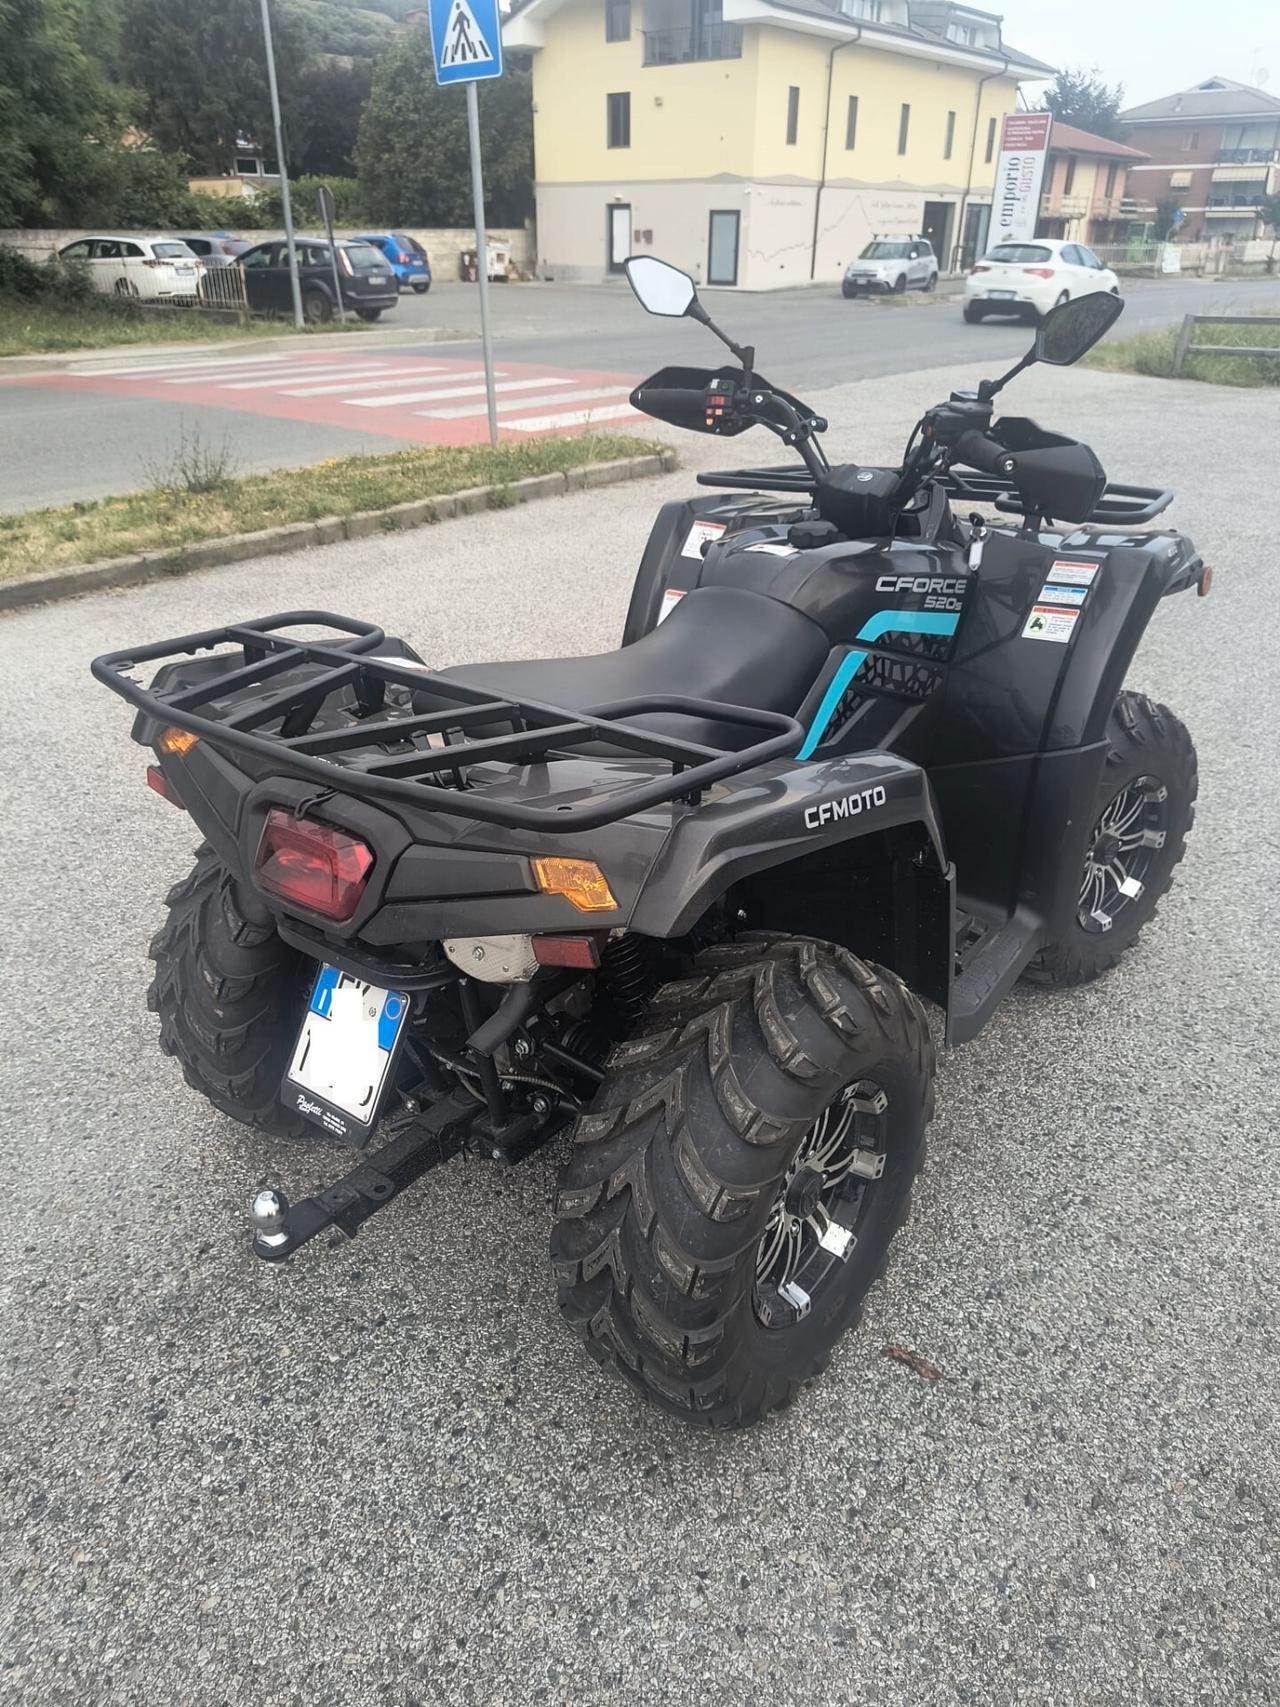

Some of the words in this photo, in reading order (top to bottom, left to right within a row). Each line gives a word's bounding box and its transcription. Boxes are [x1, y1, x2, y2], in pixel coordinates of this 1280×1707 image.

[1000, 157, 1021, 227] emporio
[1019, 156, 1036, 193] GUSTO
[875, 576, 967, 594] CFORCE
[924, 596, 962, 610] 520s
[804, 785, 887, 829] CFMOTO
